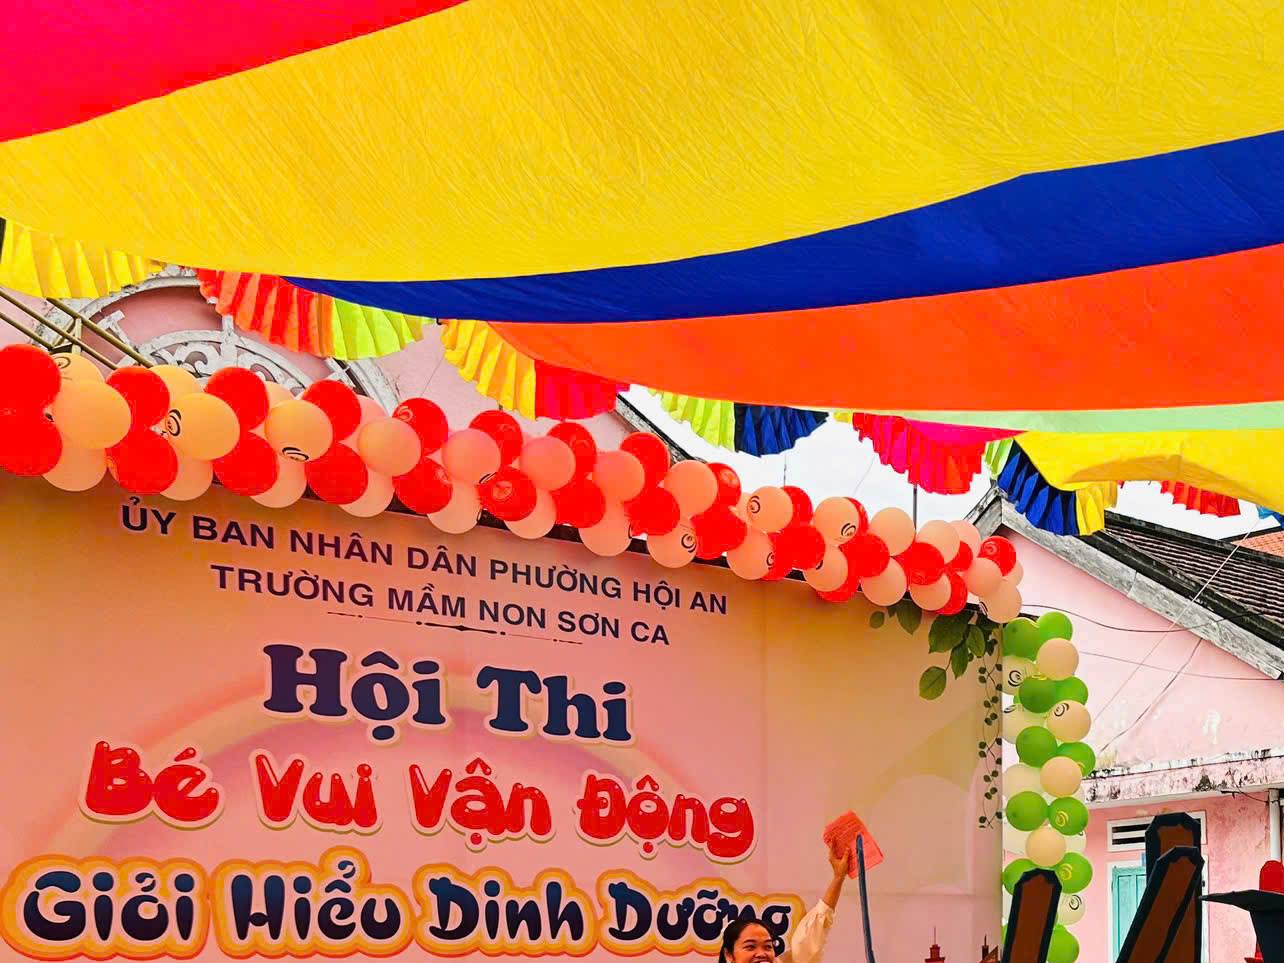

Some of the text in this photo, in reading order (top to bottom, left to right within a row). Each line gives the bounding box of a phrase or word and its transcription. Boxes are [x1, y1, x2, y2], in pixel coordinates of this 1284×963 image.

[122, 496, 727, 615] ỦY BAN NHÂN DÂN PHƯỜNG HỘI AN
[210, 564, 670, 645] TRƯỜNG MẦM NON SƠN CA
[262, 643, 632, 742] Hội Thi
[85, 740, 755, 858] Bé Vui Vận Động
[23, 870, 195, 942] Giỏi
[230, 859, 401, 941] Hiểu
[428, 876, 585, 941] Dinh
